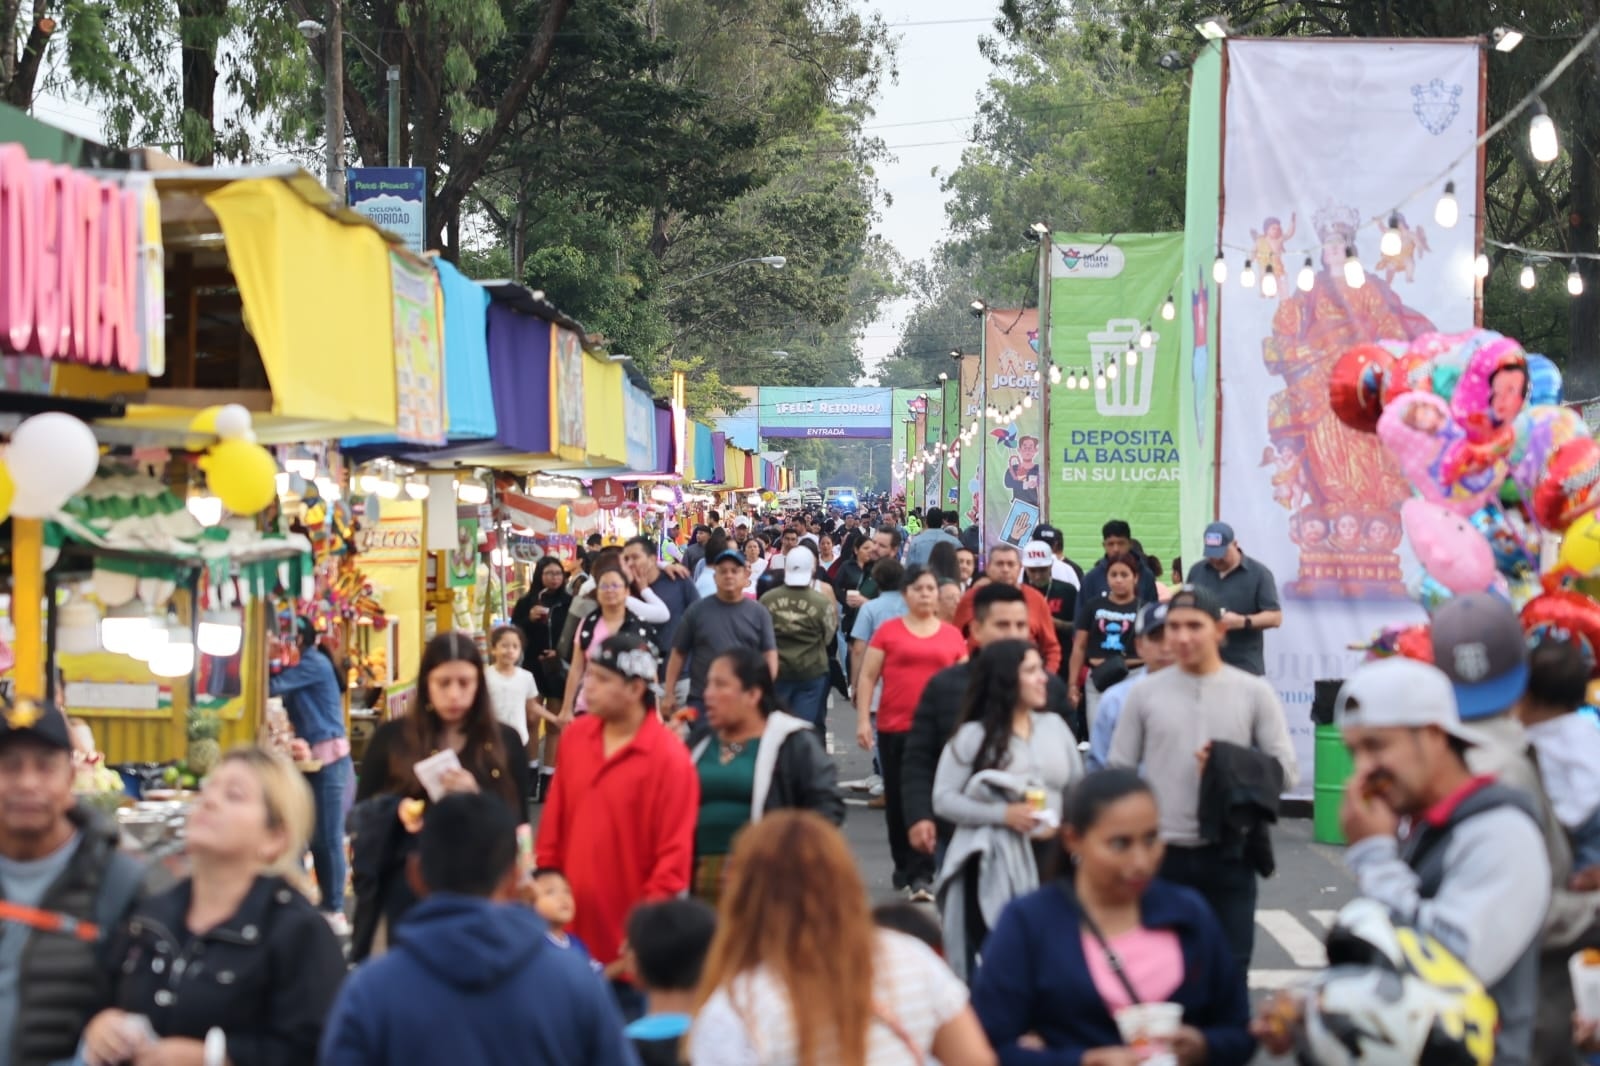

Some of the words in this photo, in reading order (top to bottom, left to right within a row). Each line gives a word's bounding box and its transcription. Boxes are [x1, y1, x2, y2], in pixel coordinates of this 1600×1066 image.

[367, 212, 410, 224] RIORIDAD
[1083, 254, 1109, 262] Muni
[1083, 261, 1109, 269] Guate
[806, 428, 846, 436] ENTRADA
[1071, 430, 1174, 445] DEPOSITA
[1063, 448, 1090, 464] LA
[1095, 448, 1181, 464] BASURA
[1061, 467, 1088, 482] EN
[1091, 467, 1117, 482] SU
